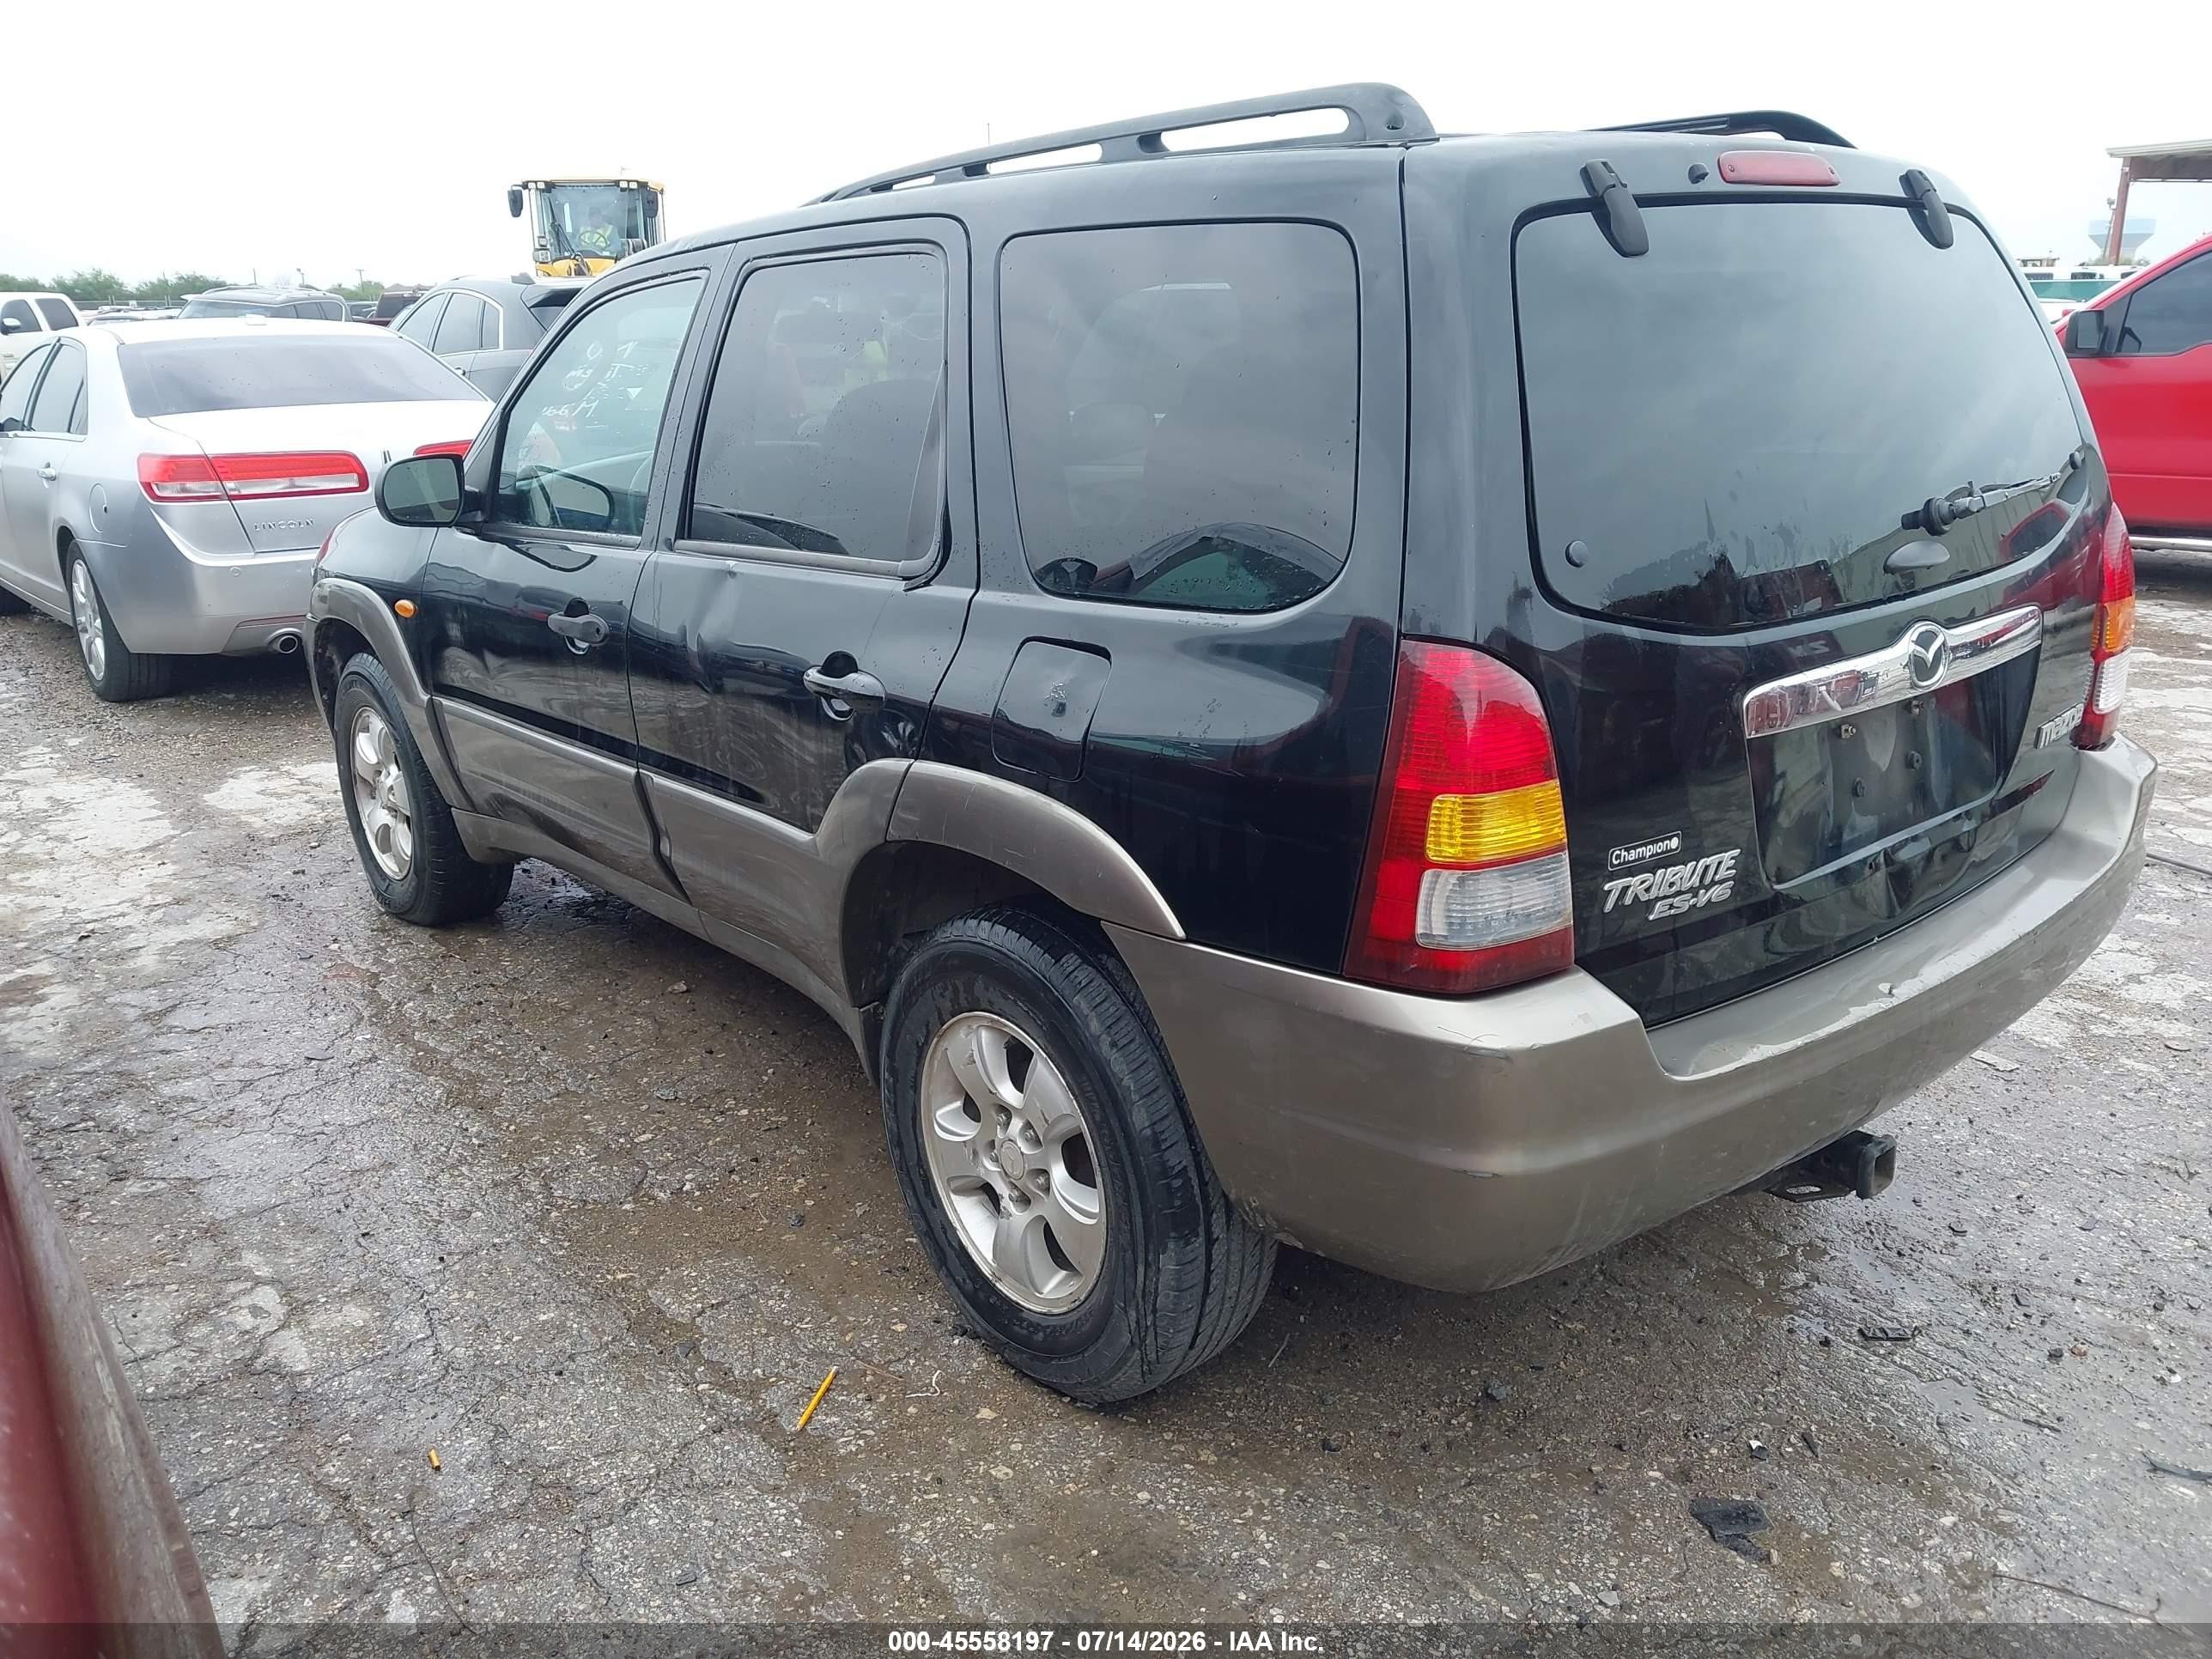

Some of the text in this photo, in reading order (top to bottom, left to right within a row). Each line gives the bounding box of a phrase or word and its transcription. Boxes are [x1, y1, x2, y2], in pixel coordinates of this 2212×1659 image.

[254, 519, 313, 531] LINCOLN
[1612, 840, 1671, 865] Champion
[1602, 848, 1741, 914] TRIBUTE
